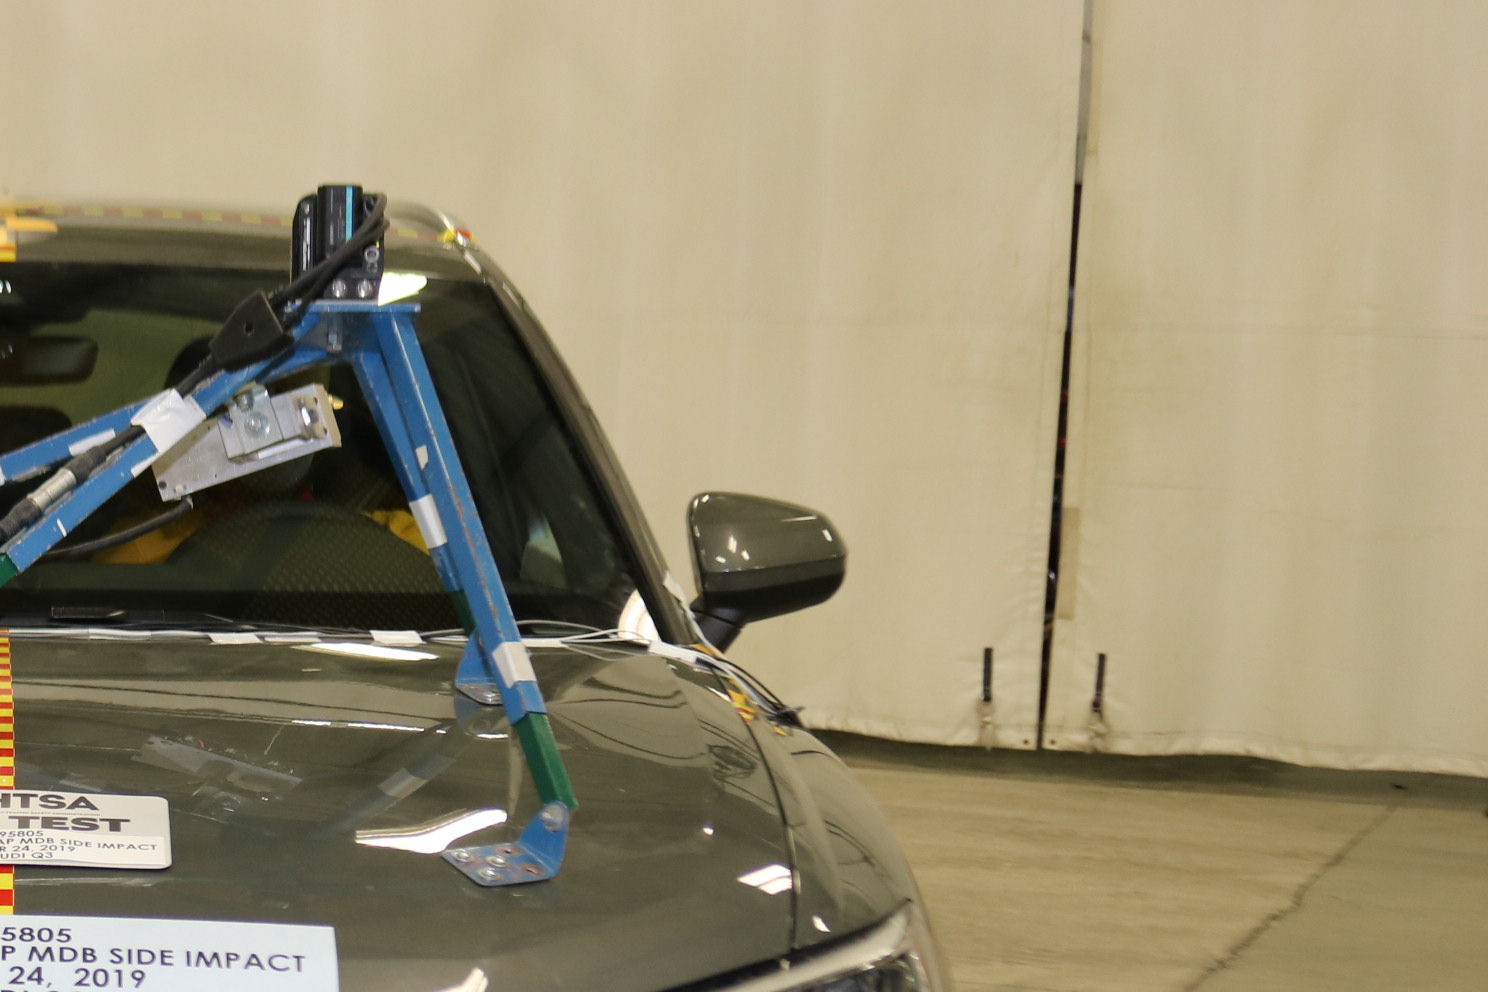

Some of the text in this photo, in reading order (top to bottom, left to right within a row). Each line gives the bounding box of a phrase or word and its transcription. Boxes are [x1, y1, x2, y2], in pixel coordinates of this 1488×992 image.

[8, 815, 131, 832] TEST
[12, 845, 34, 853] 24,
[40, 844, 76, 852] 2019
[60, 838, 93, 848] SIDE
[97, 842, 158, 851] IMPACT
[31, 851, 53, 859] Q3
[27, 946, 98, 963] MDB
[109, 948, 175, 967] SIDE
[186, 950, 306, 973] IMPACT
[8, 966, 53, 988] 24,
[73, 967, 147, 989] 2019
